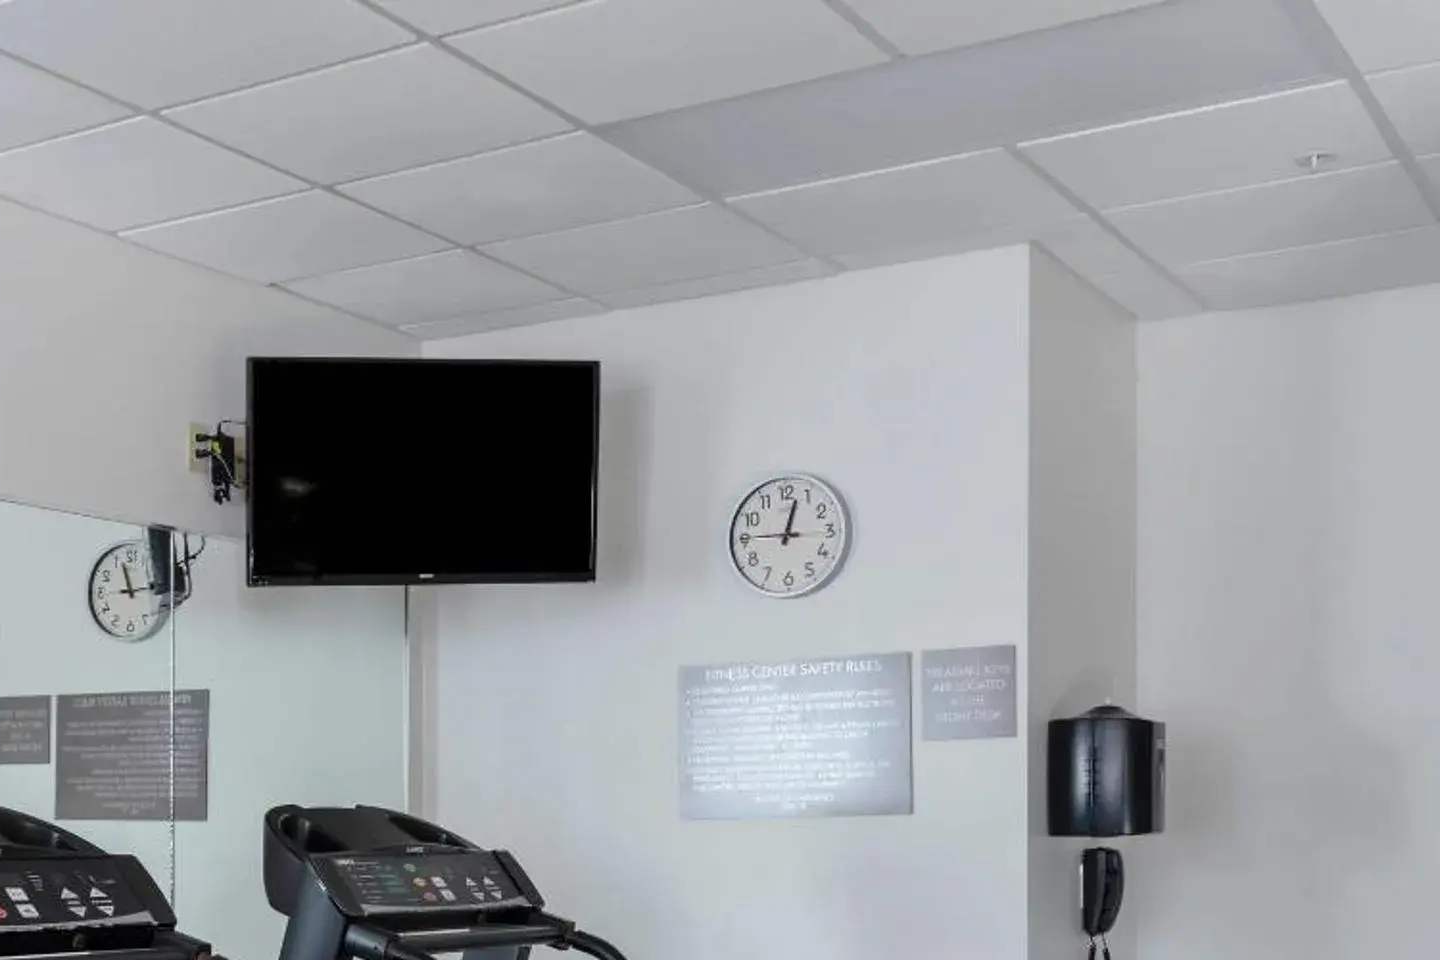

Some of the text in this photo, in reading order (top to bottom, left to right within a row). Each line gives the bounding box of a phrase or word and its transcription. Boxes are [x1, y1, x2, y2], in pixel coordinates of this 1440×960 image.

[777, 484, 794, 500] 12
[804, 489, 811, 504] 1
[760, 495, 771, 509] 11
[816, 503, 827, 519] 2
[744, 512, 760, 527] 10
[825, 523, 835, 539] 3
[740, 533, 751, 549] 9
[817, 543, 829, 559] 4
[747, 552, 759, 567] 8
[764, 567, 773, 581] 7
[804, 562, 815, 577] 5
[783, 571, 794, 587] 6
[799, 661, 841, 677] SAFETY
